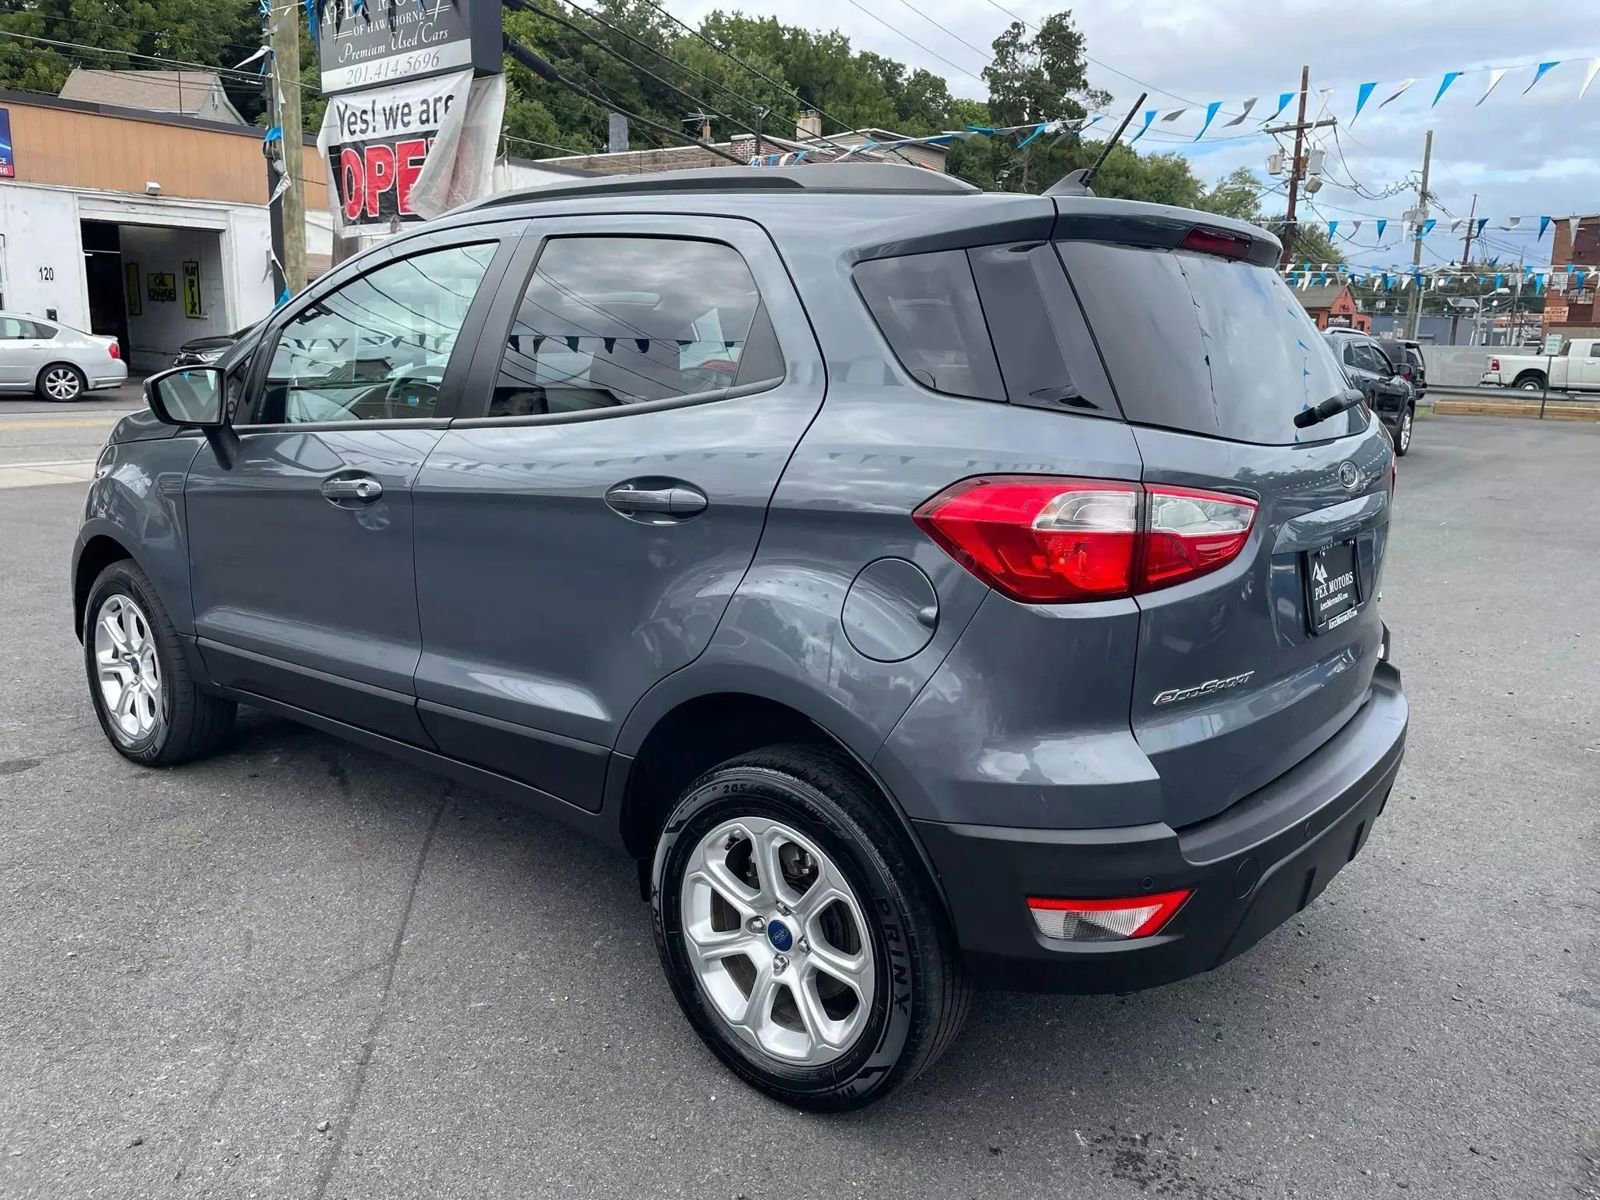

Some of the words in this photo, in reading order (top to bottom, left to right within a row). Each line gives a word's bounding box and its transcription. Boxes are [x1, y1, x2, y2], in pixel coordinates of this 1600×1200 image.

[338, 43, 386, 63] Premium
[391, 21, 424, 51] Used
[422, 23, 449, 44] Cars
[353, 25, 365, 37] OF
[346, 50, 440, 86] 201.414.5696
[336, 99, 376, 137] Yes!
[383, 101, 412, 131] we
[38, 266, 54, 281] 120
[1329, 571, 1354, 594] MOTORS
[872, 896, 911, 1017] PRINX
